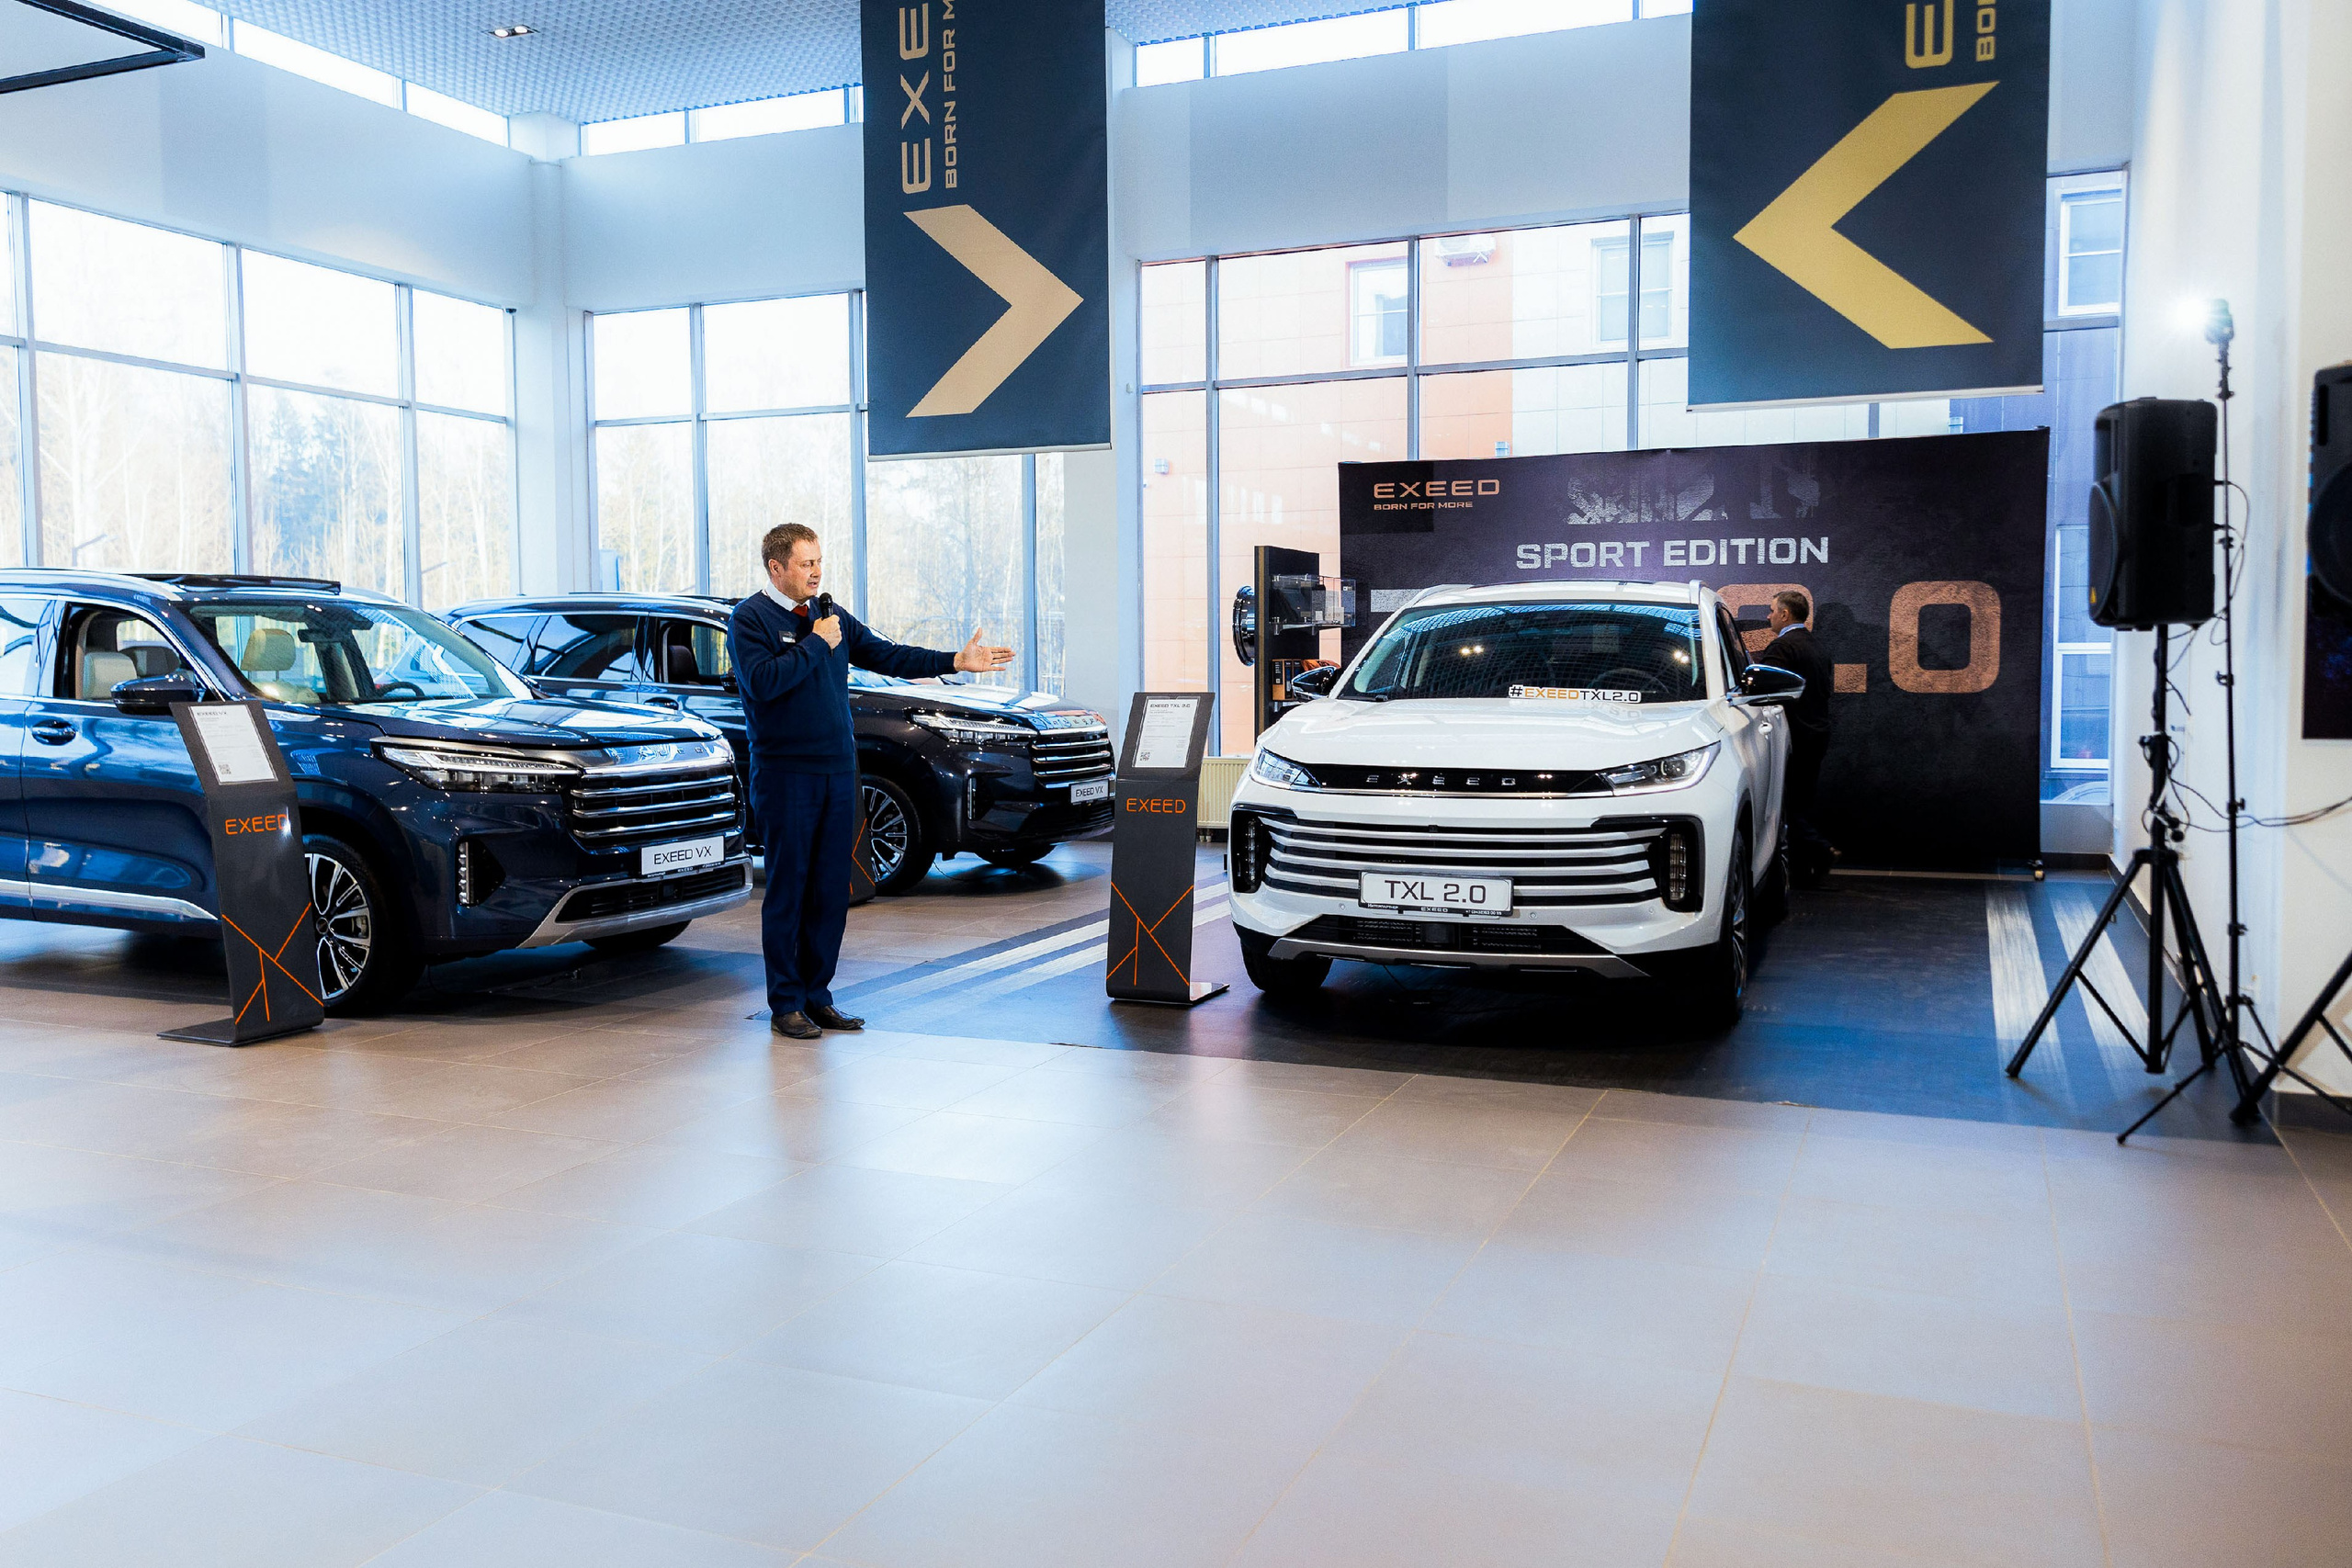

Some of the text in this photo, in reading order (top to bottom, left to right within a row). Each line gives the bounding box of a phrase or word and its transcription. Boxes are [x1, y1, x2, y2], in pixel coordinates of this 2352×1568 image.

[1975, 0, 1996, 62] BO
[943, 28, 956, 92] FOR
[944, 100, 957, 188] BORN
[1374, 479, 1500, 499] EXEED
[1438, 501, 1474, 509] MORE
[1516, 536, 1829, 569] SPORT EDITION
[1510, 685, 1639, 702] #EXEEDTXL2.0
[1076, 785, 1103, 797] EXEED VX
[1126, 797, 1186, 814] EXEED
[653, 848, 693, 865] EXEED
[695, 845, 712, 858] VX
[1385, 880, 1487, 904] TXL 2.0
